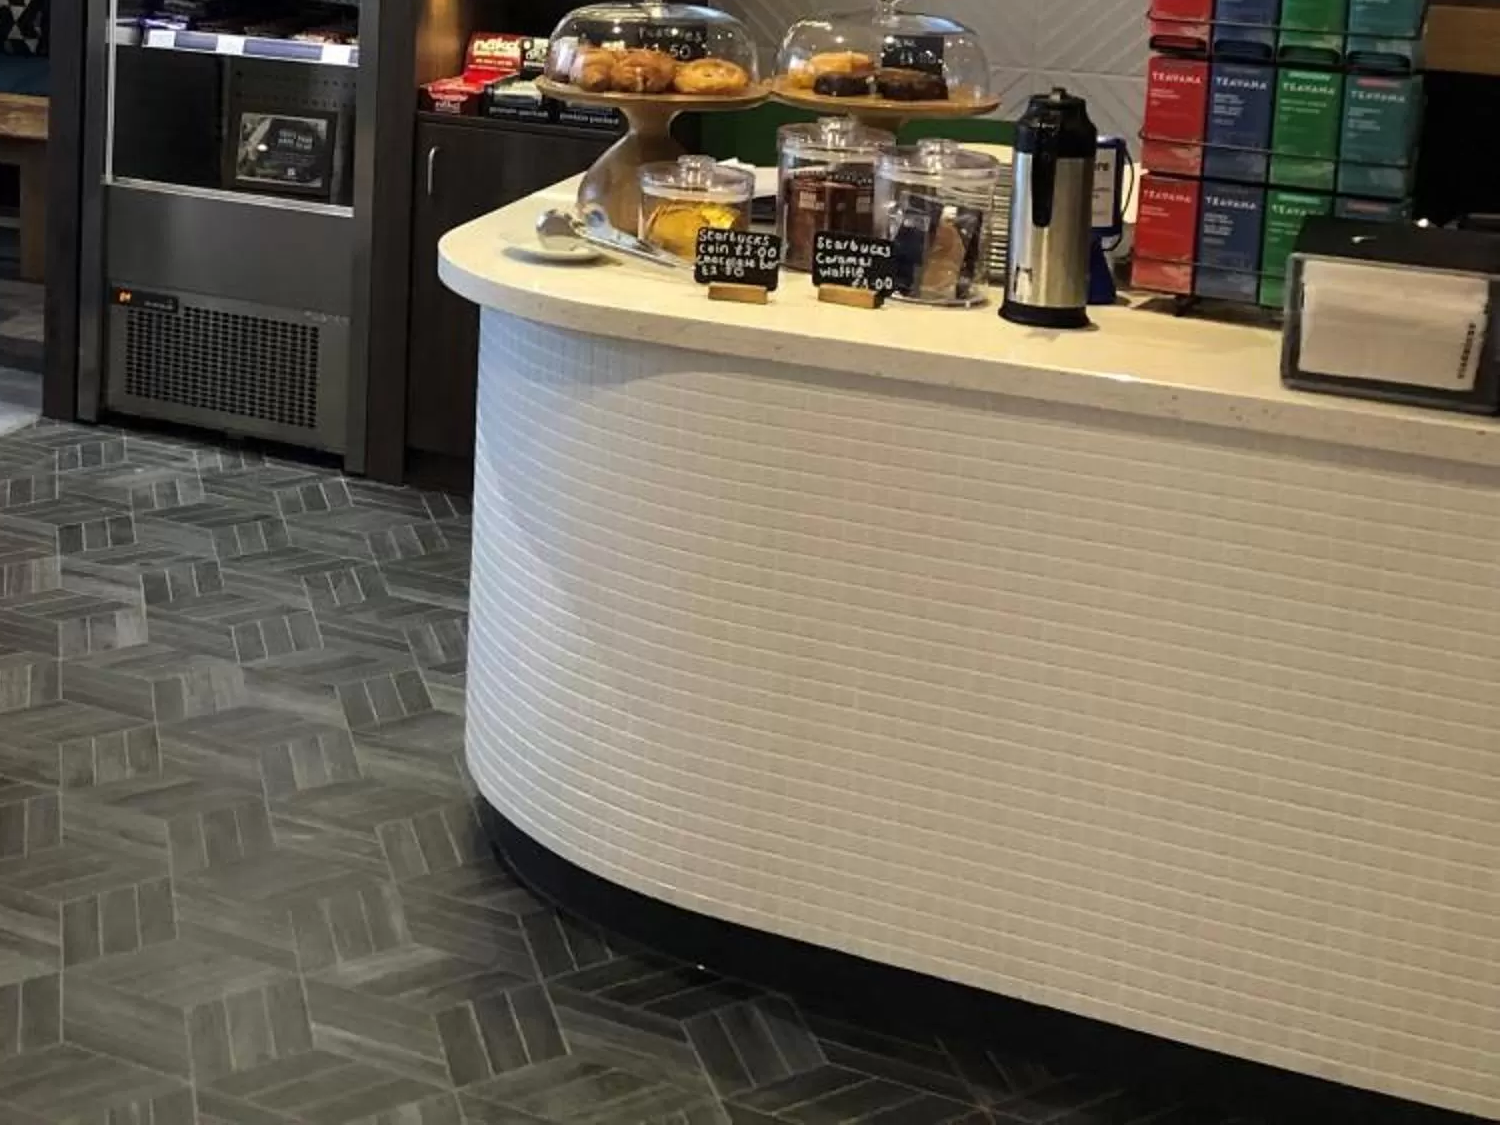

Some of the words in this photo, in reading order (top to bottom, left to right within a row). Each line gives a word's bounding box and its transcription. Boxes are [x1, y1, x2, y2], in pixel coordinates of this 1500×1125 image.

[1152, 70, 1202, 84] TEAVANA
[1215, 76, 1268, 90] TEAVANA
[1283, 82, 1336, 95] TEAVANA
[1143, 189, 1192, 203] TEAVANA
[1204, 195, 1257, 210] TEAVANA
